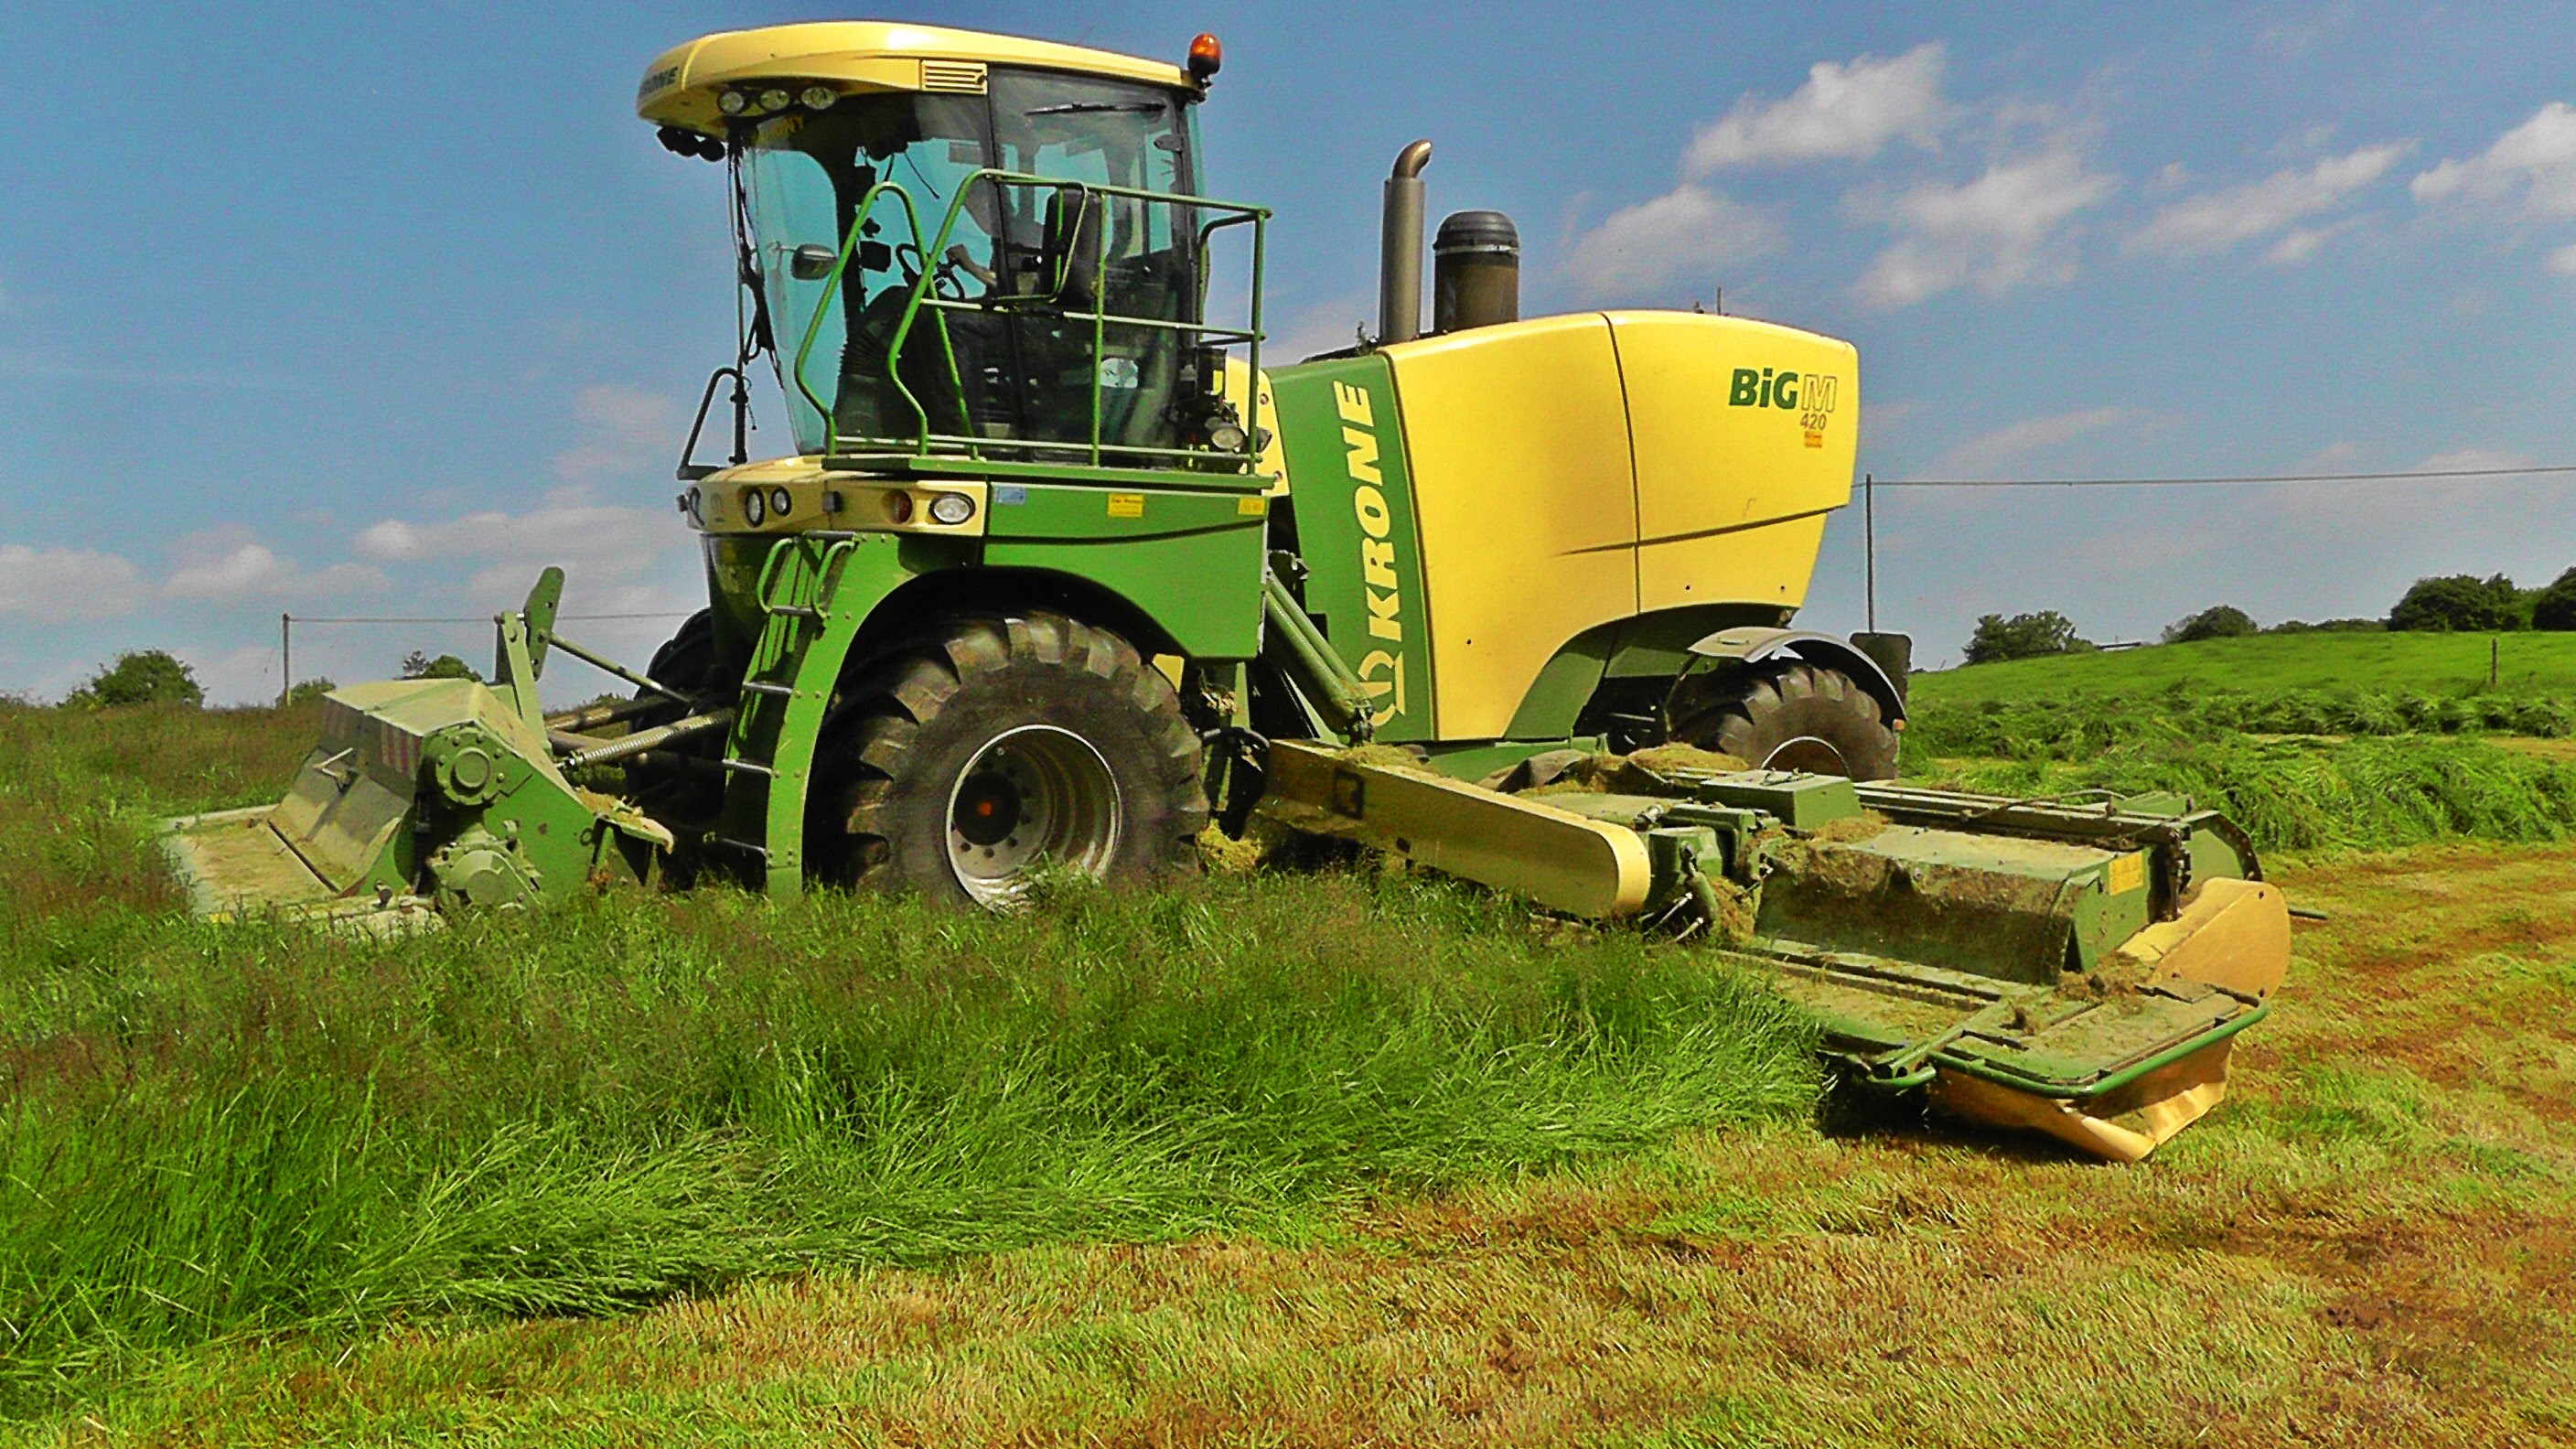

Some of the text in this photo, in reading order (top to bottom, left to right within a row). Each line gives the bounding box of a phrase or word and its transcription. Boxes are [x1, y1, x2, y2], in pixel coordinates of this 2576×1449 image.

[1728, 367, 1798, 410] BiG
[1799, 413, 1827, 431] 420
[1333, 380, 1402, 642] KRONE
